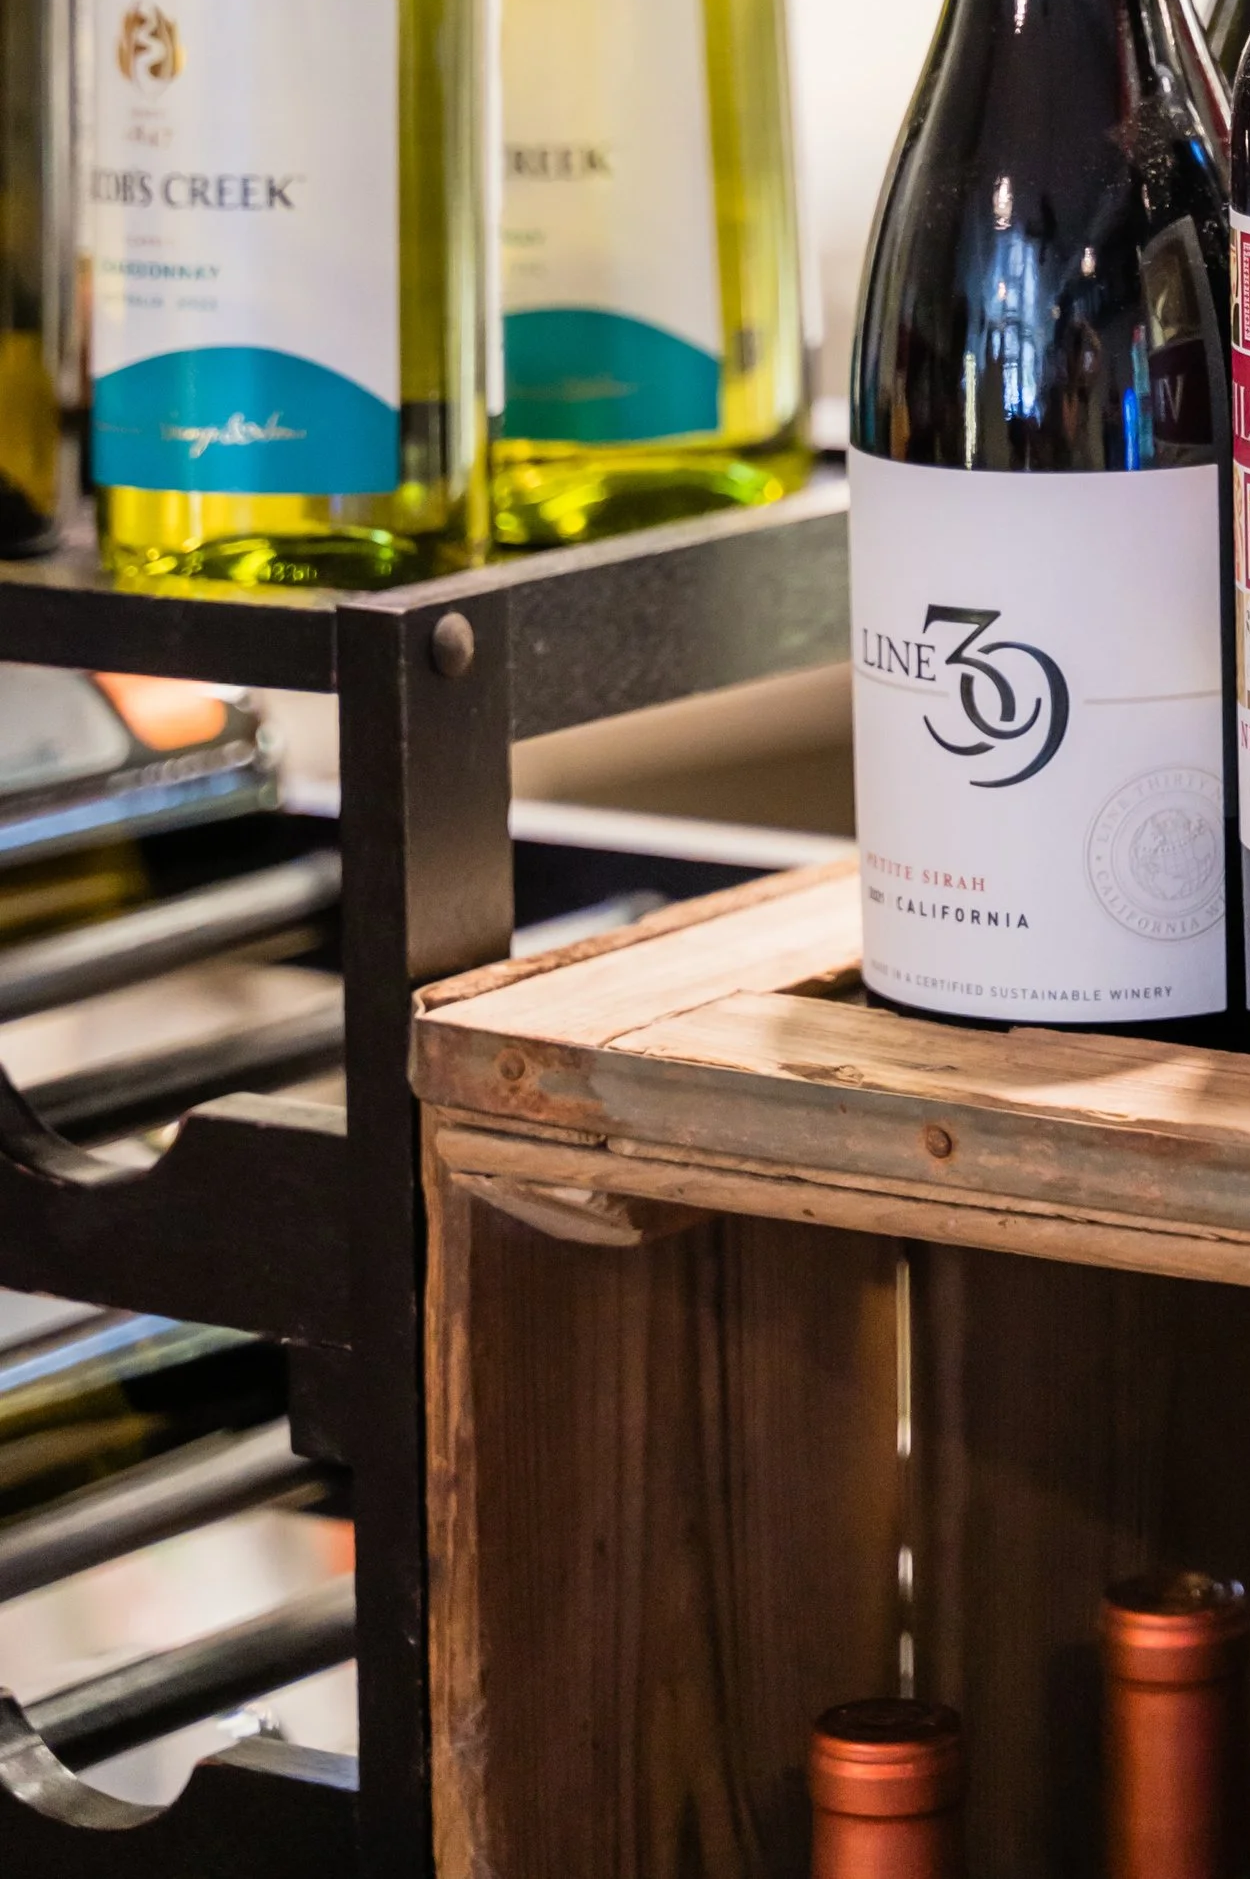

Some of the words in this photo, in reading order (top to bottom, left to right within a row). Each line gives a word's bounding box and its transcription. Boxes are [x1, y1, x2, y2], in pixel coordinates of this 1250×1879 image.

[502, 148, 614, 181] REEK
[163, 172, 296, 210] CREEK
[863, 628, 937, 682] LINE
[866, 851, 914, 881] PETITE
[922, 869, 986, 893] SIRAH
[896, 895, 1030, 929] CALIFORNIA
[916, 974, 984, 997] CERTIFIED
[989, 984, 1102, 1002] SUSTAINABLE
[1109, 985, 1173, 1001] WINERY
